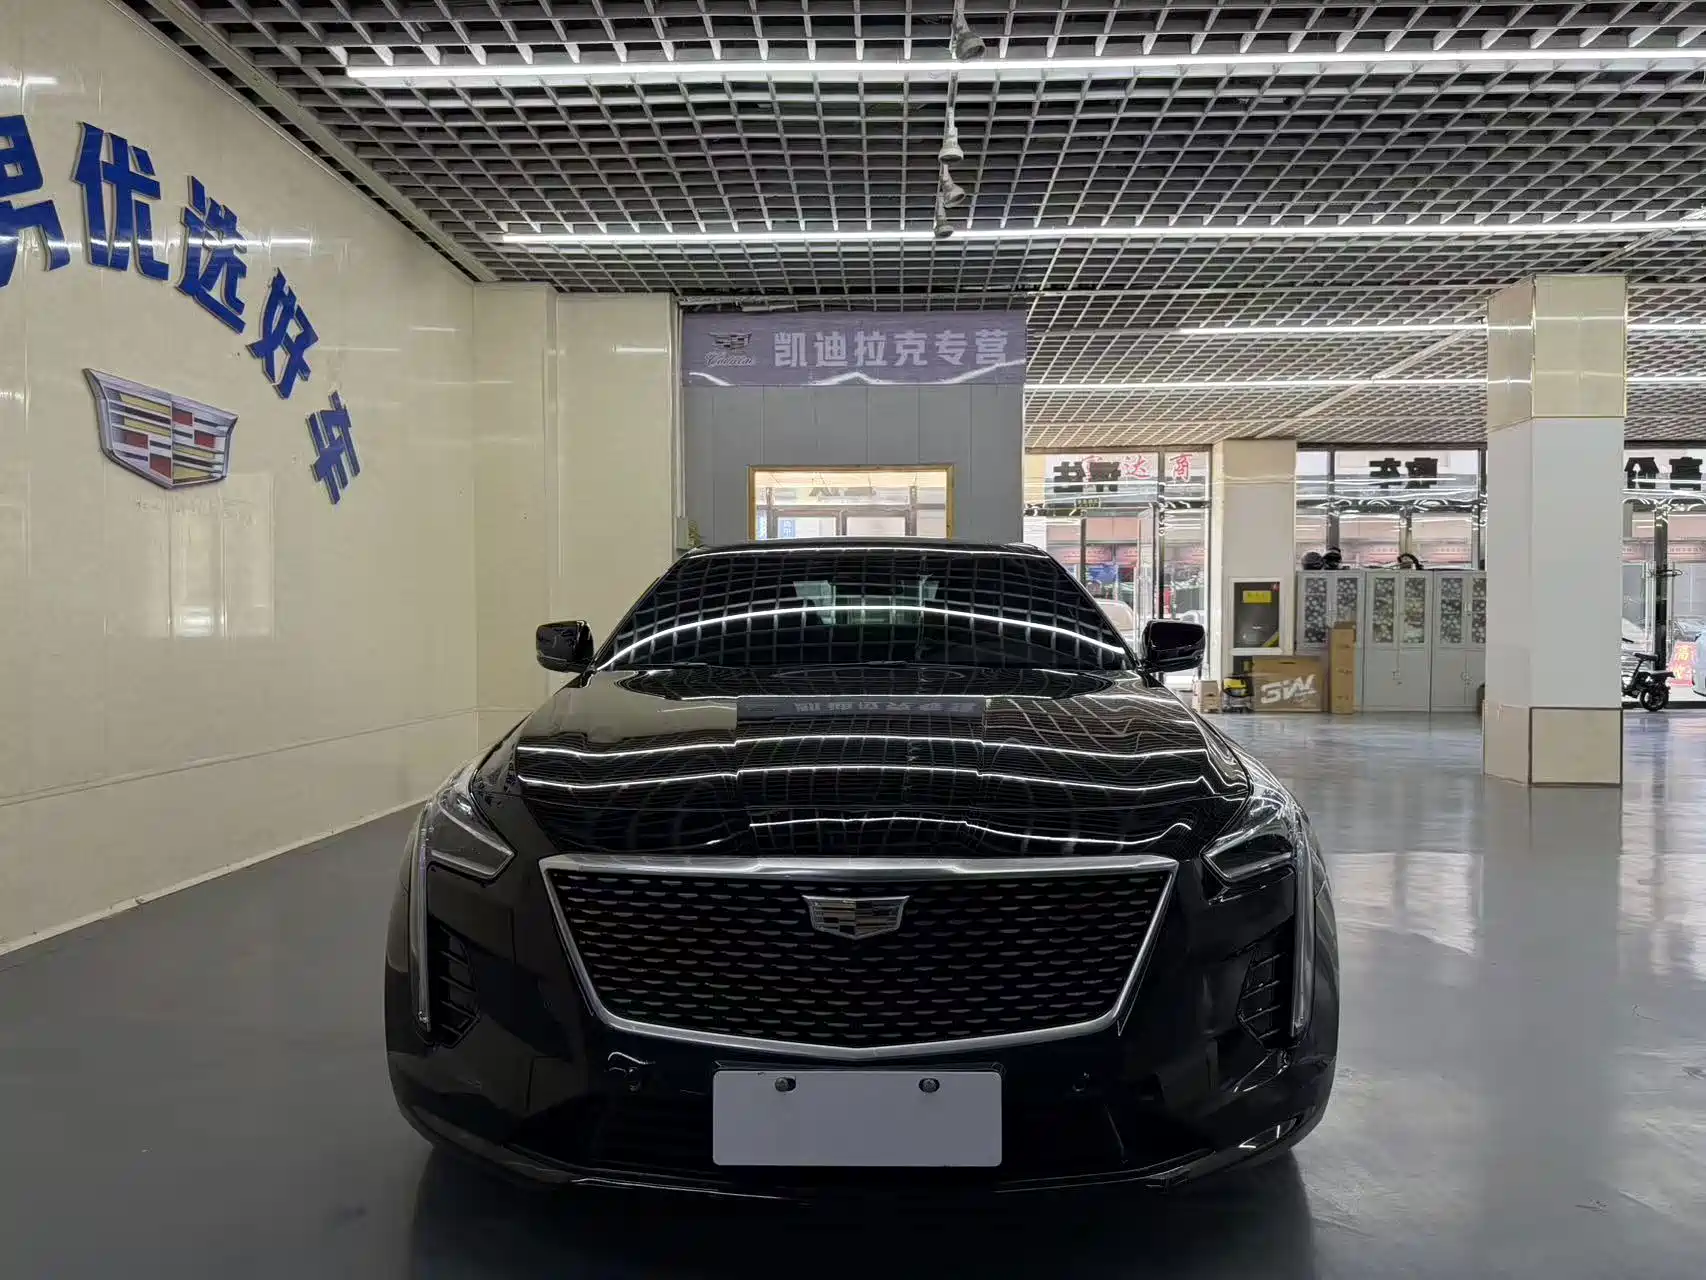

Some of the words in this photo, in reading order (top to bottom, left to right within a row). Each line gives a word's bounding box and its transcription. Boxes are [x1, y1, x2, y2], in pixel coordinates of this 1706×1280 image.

[773, 329, 1009, 368] 凯迪拉克专营
